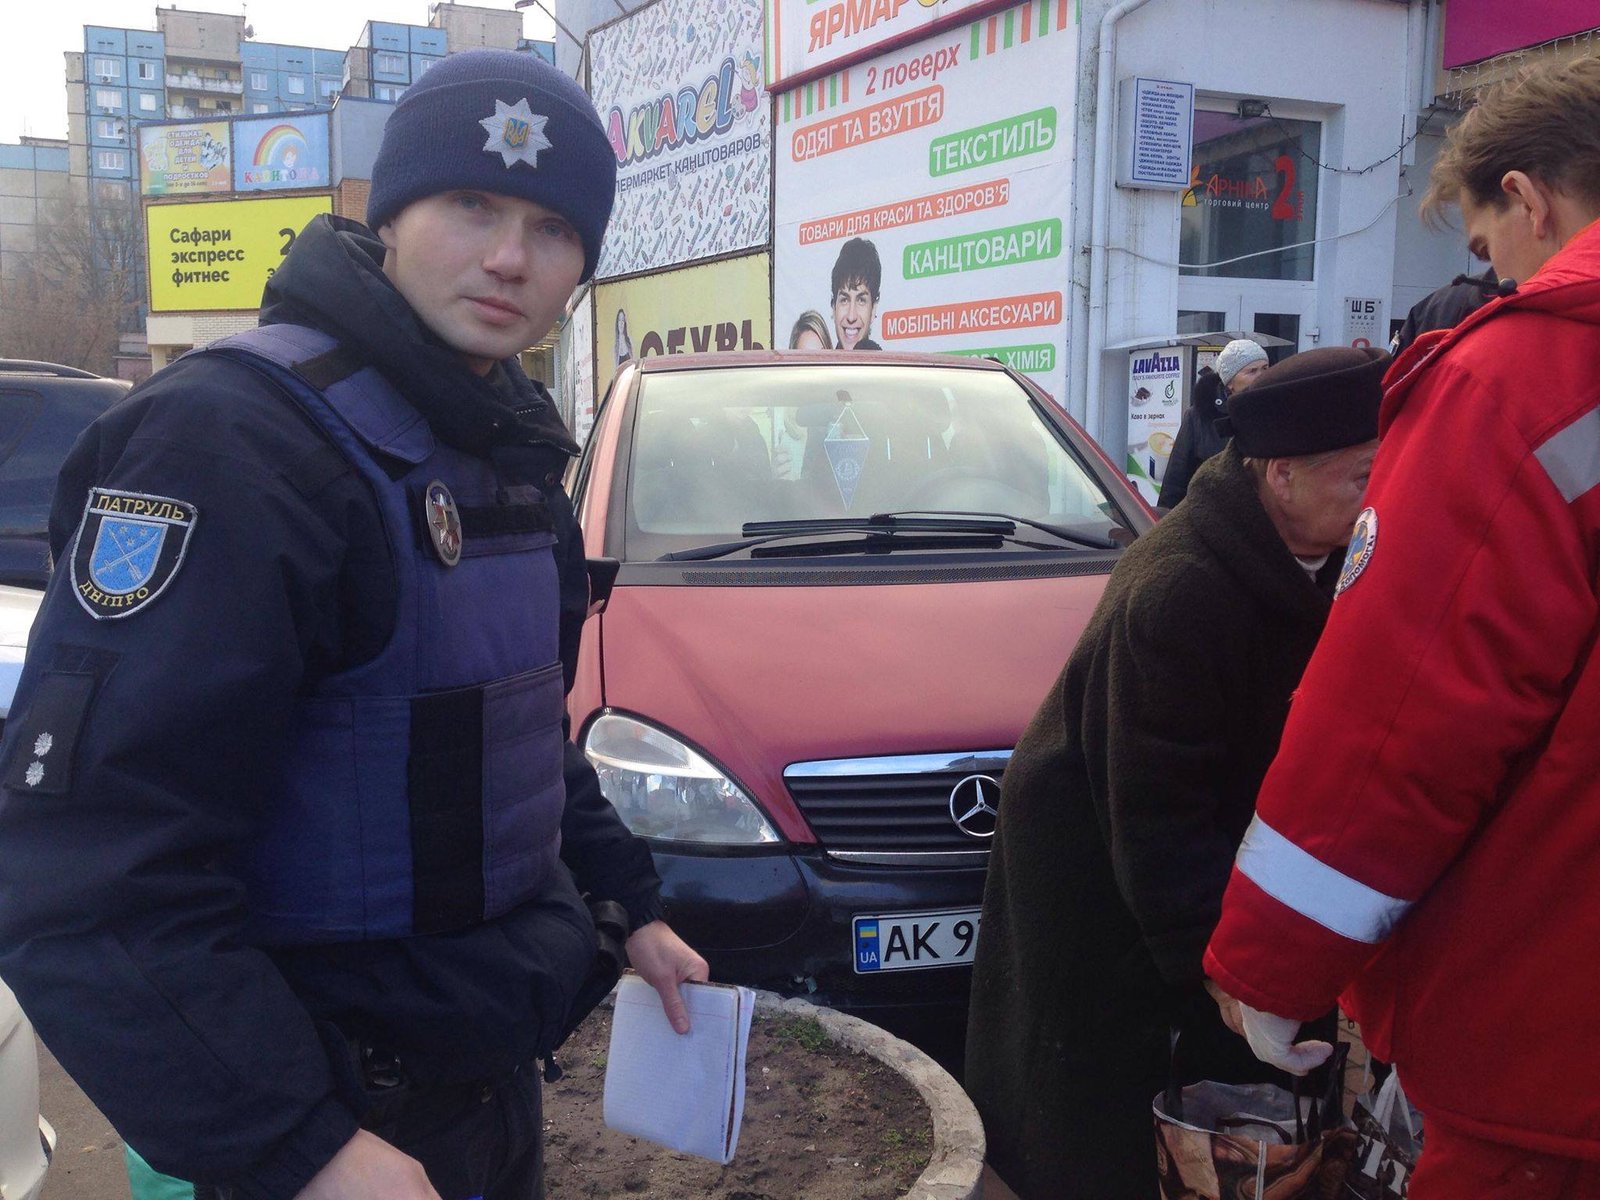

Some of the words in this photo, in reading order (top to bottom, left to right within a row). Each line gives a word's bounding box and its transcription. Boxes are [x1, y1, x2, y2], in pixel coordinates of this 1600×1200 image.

[866, 67, 876, 95] 2
[882, 44, 961, 90] поверх
[795, 124, 837, 159] ОДЯГ
[843, 117, 864, 144] ТА
[869, 91, 941, 136] ВЗУТТЯ
[169, 139, 200, 148] ОДЕЖДА
[674, 133, 761, 175] КАНЦТОВАРОВ
[932, 118, 1053, 172] ТЕКСТИЛЬ
[1271, 154, 1296, 221] 2
[801, 223, 844, 242] ТОВАРИ
[846, 214, 870, 235] ДЛЯ
[873, 206, 914, 228] КРАСИ
[917, 201, 933, 217] ТА
[936, 183, 1009, 216] ЗДОРОВ'Я
[1204, 199, 1242, 208] торговий
[1245, 201, 1270, 211] центр
[170, 227, 231, 246] Сафари
[278, 228, 297, 256] 2
[910, 226, 1052, 275] КАНЦТОВАРИ
[171, 249, 245, 266] экспресс
[172, 268, 230, 287] фитнес
[887, 312, 955, 336] МОБІЛЬНІ
[958, 300, 1055, 329] АКСЕСУАРИ
[1006, 349, 1051, 370] ХІМІЯ
[1133, 352, 1180, 374] LAVAZZA
[97, 496, 184, 520] ПАТРУЛЬ
[79, 580, 149, 608] ДНІПРО
[884, 922, 940, 963] AK
[953, 919, 982, 958] 9
[860, 951, 878, 964] UA
